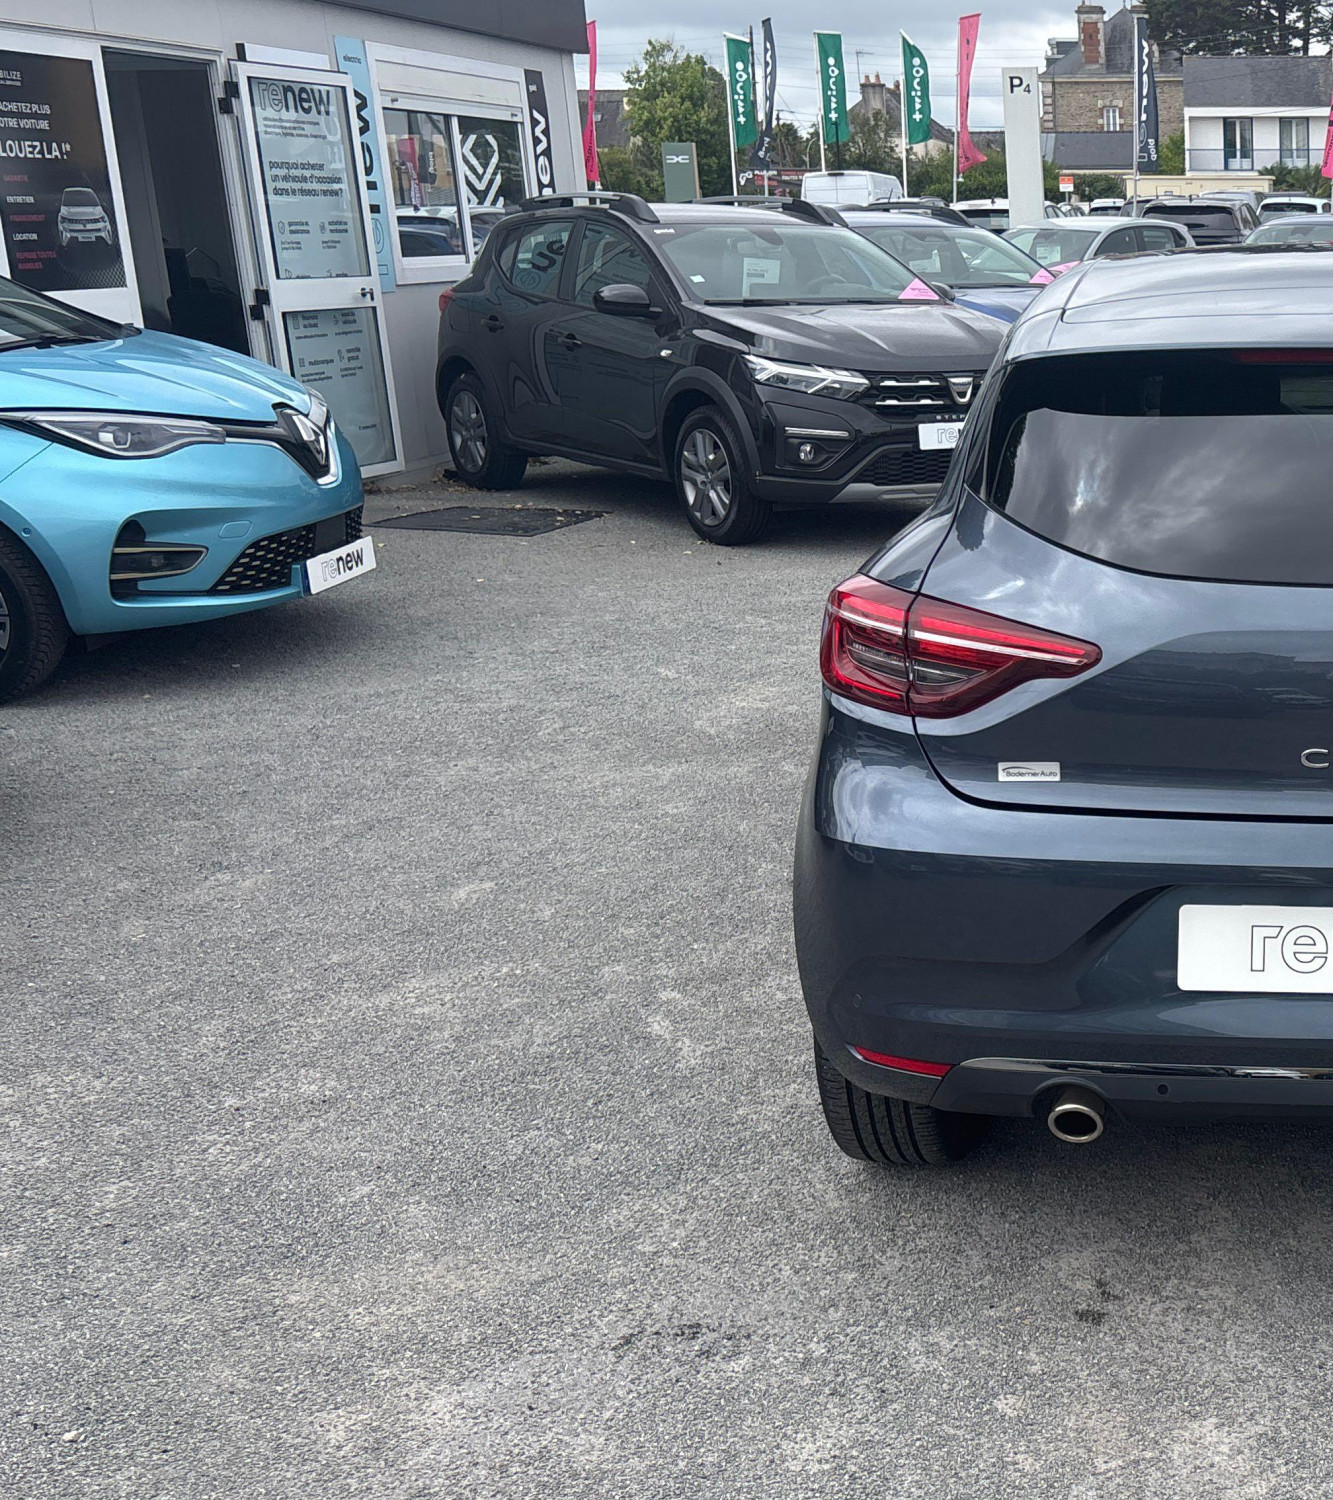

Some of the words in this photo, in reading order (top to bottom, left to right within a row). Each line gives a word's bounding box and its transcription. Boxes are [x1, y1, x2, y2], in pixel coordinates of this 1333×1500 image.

[1008, 75, 1032, 94] P4
[257, 82, 331, 116] renew
[32, 104, 51, 114] PLUS
[19, 118, 50, 130] VOITURE
[0, 140, 42, 158] LOUEZ
[43, 142, 61, 159] LA
[1147, 139, 1157, 161] gold
[269, 160, 299, 172] pourquoi
[300, 161, 325, 171] acheter
[270, 173, 280, 183] un
[280, 172, 308, 184] véhicule
[309, 174, 343, 184] d'occasion
[273, 186, 289, 196] dans
[290, 186, 297, 196] le
[297, 186, 320, 197] réseau
[12, 232, 38, 241] LOCATION
[320, 547, 364, 582] renew
